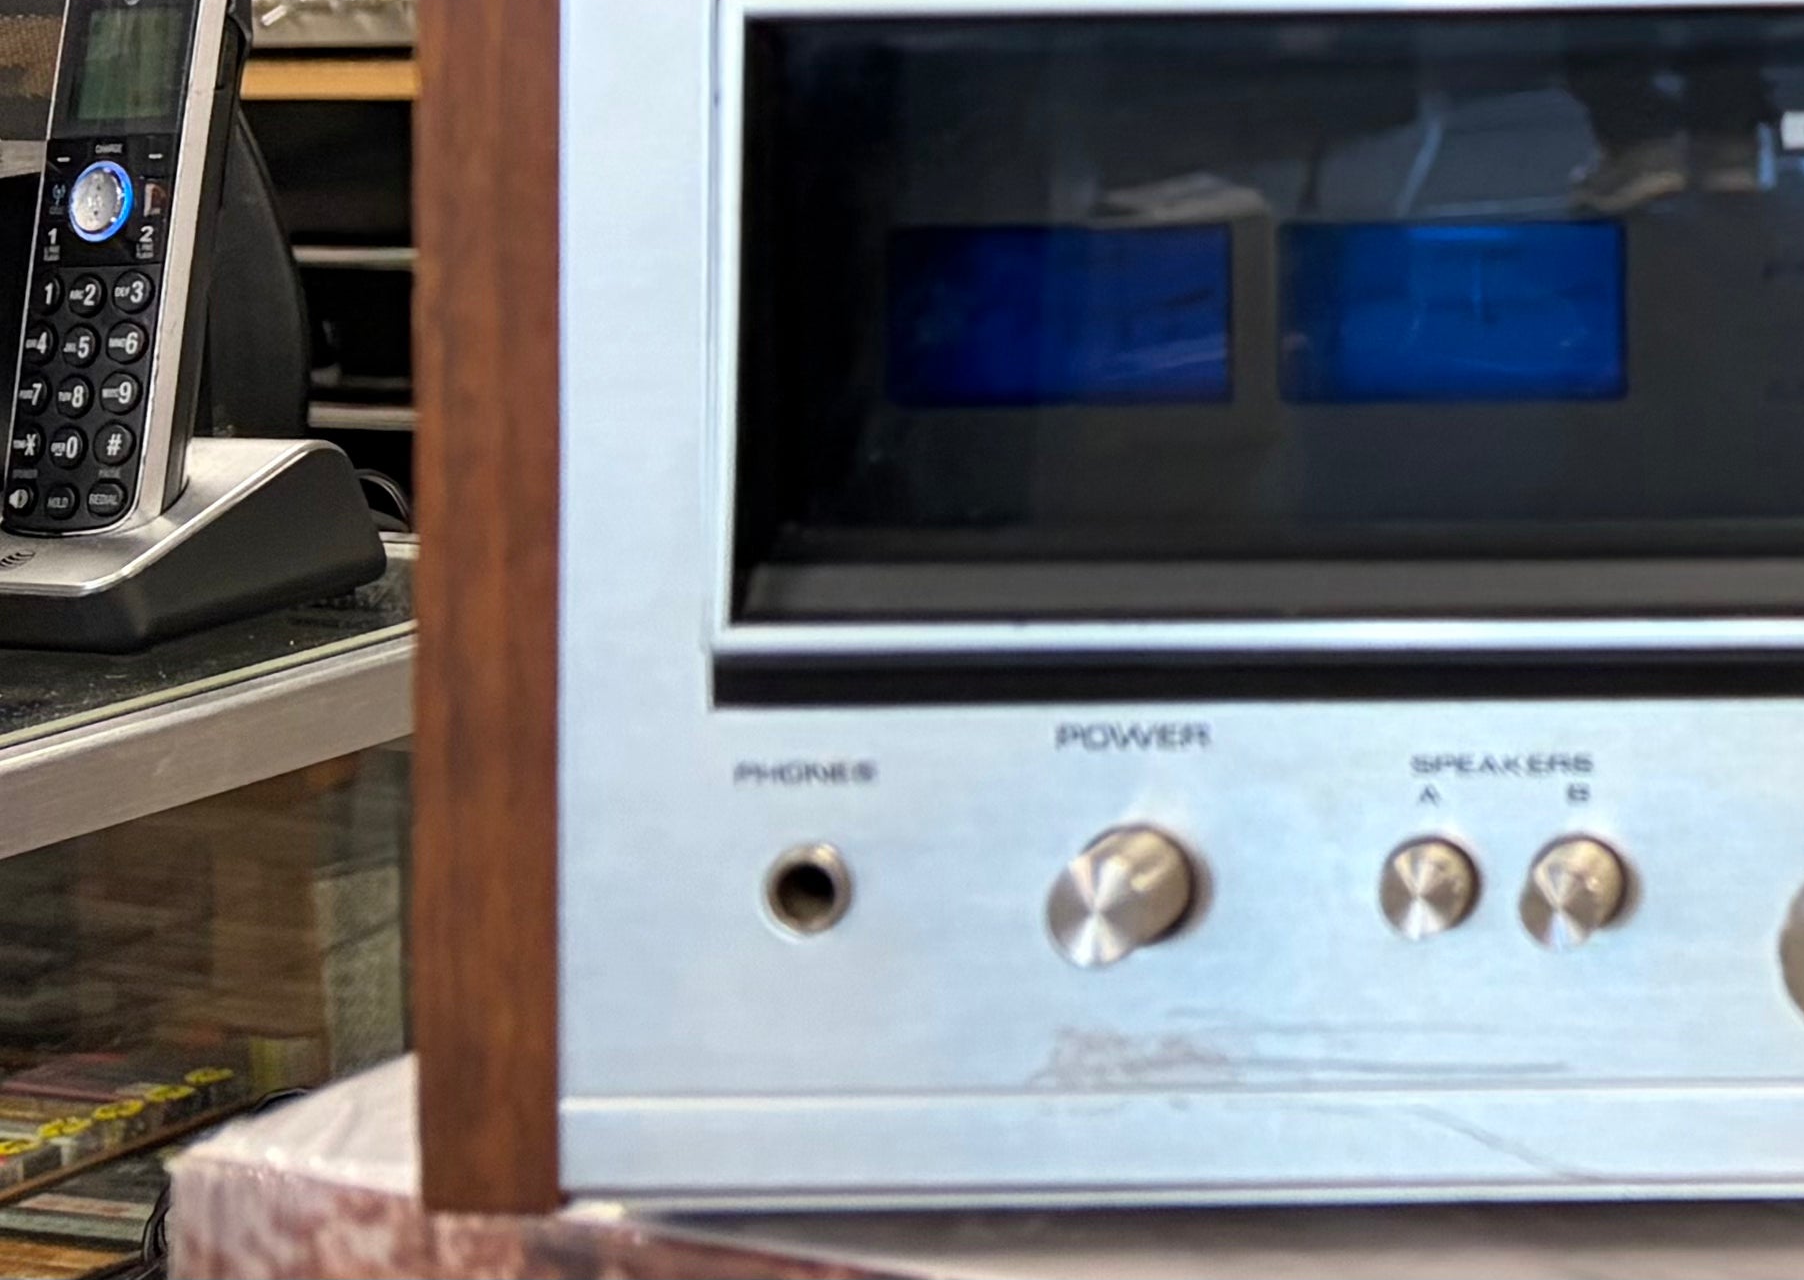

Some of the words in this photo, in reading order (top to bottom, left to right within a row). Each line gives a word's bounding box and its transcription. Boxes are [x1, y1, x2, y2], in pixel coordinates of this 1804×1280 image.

[48, 228, 58, 245] 1
[140, 225, 154, 243] 2
[44, 282, 53, 305] 1
[83, 284, 97, 306] 2
[130, 280, 144, 303] 3
[37, 331, 48, 354] 4
[77, 336, 90, 359] 5
[125, 331, 139, 355] 6
[31, 382, 42, 406] 7
[71, 385, 84, 408] 8
[118, 381, 132, 404] 9
[66, 436, 78, 459] 0
[1053, 721, 1213, 752] POWER
[733, 759, 879, 786] PHONES
[1408, 752, 1594, 776] SPEAKERS
[1418, 784, 1442, 807] A
